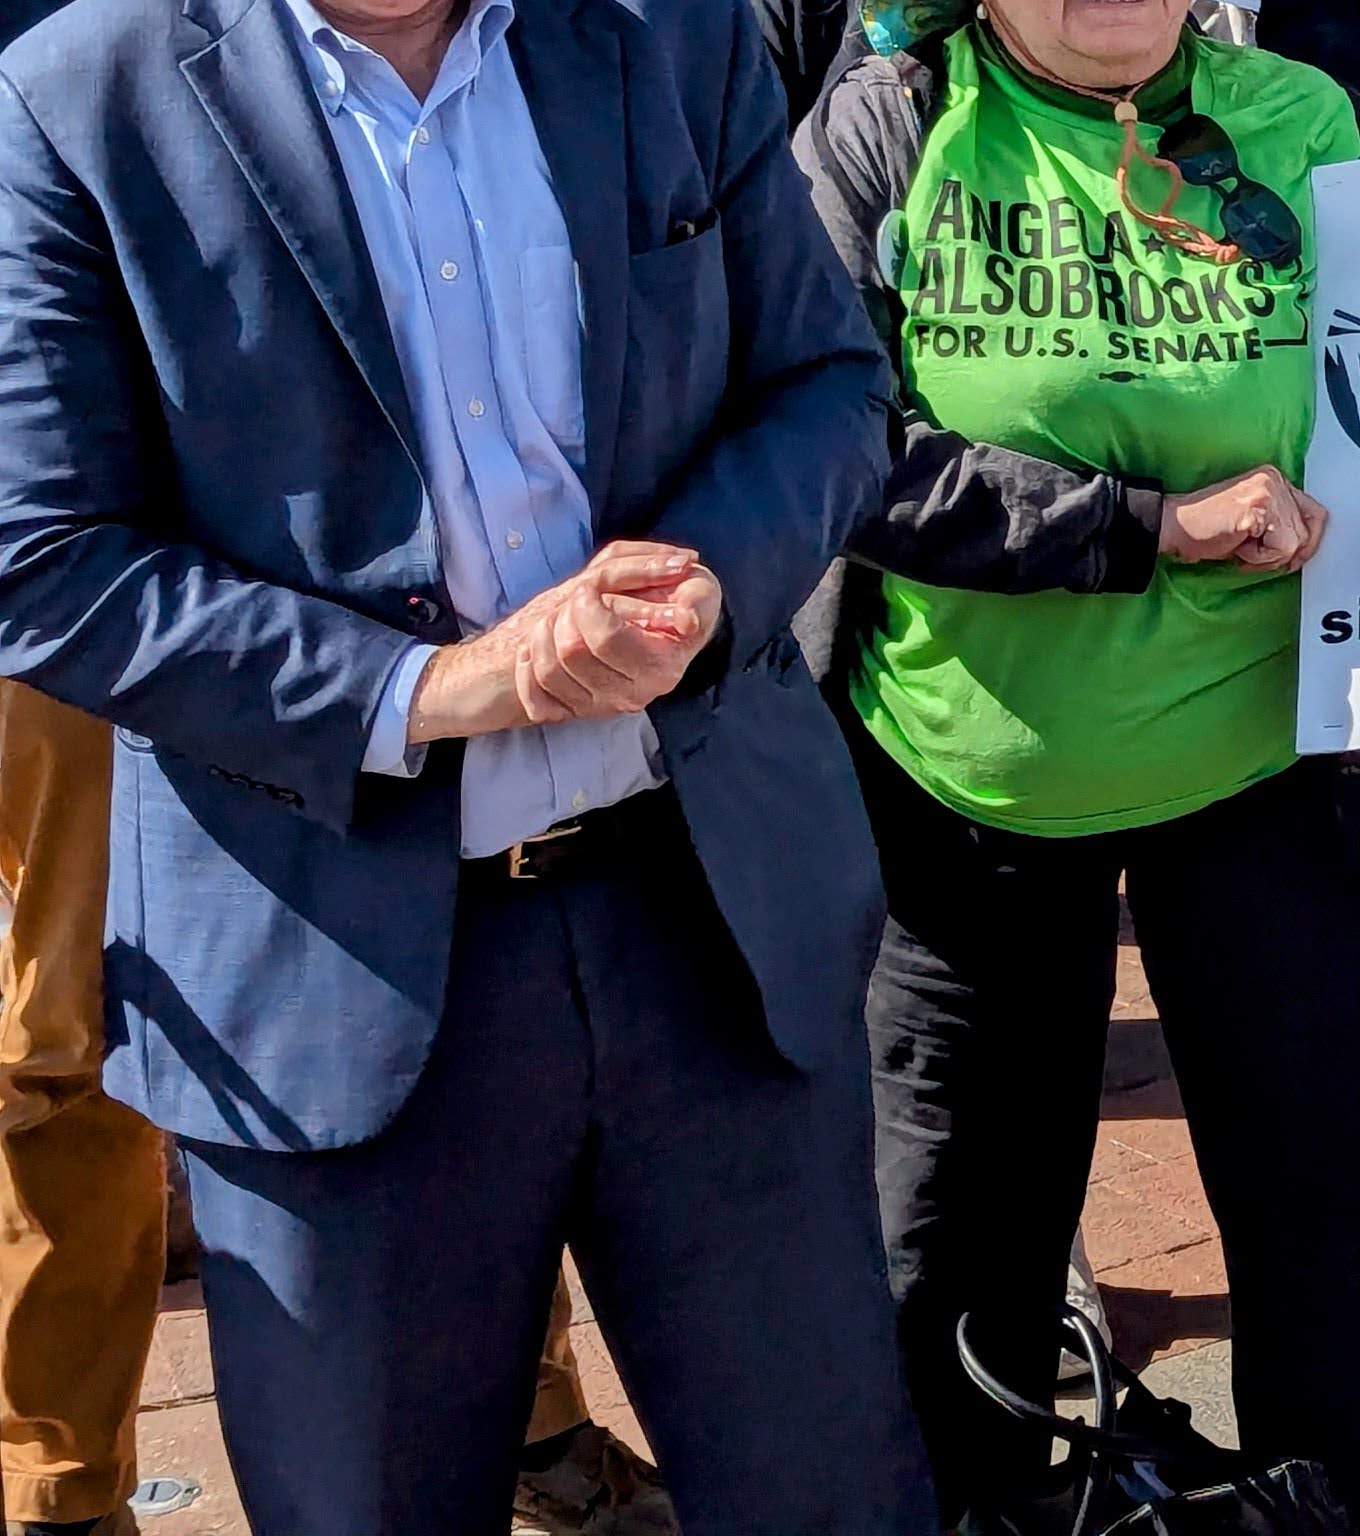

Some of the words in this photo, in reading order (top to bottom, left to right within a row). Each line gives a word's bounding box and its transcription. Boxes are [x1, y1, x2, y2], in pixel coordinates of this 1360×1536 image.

[926, 179, 1137, 264] ANGELA
[911, 248, 1275, 328] ALSOBROOKS
[915, 324, 987, 358] FOR
[1005, 326, 1089, 358] U.S.
[1108, 328, 1263, 363] SENATE
